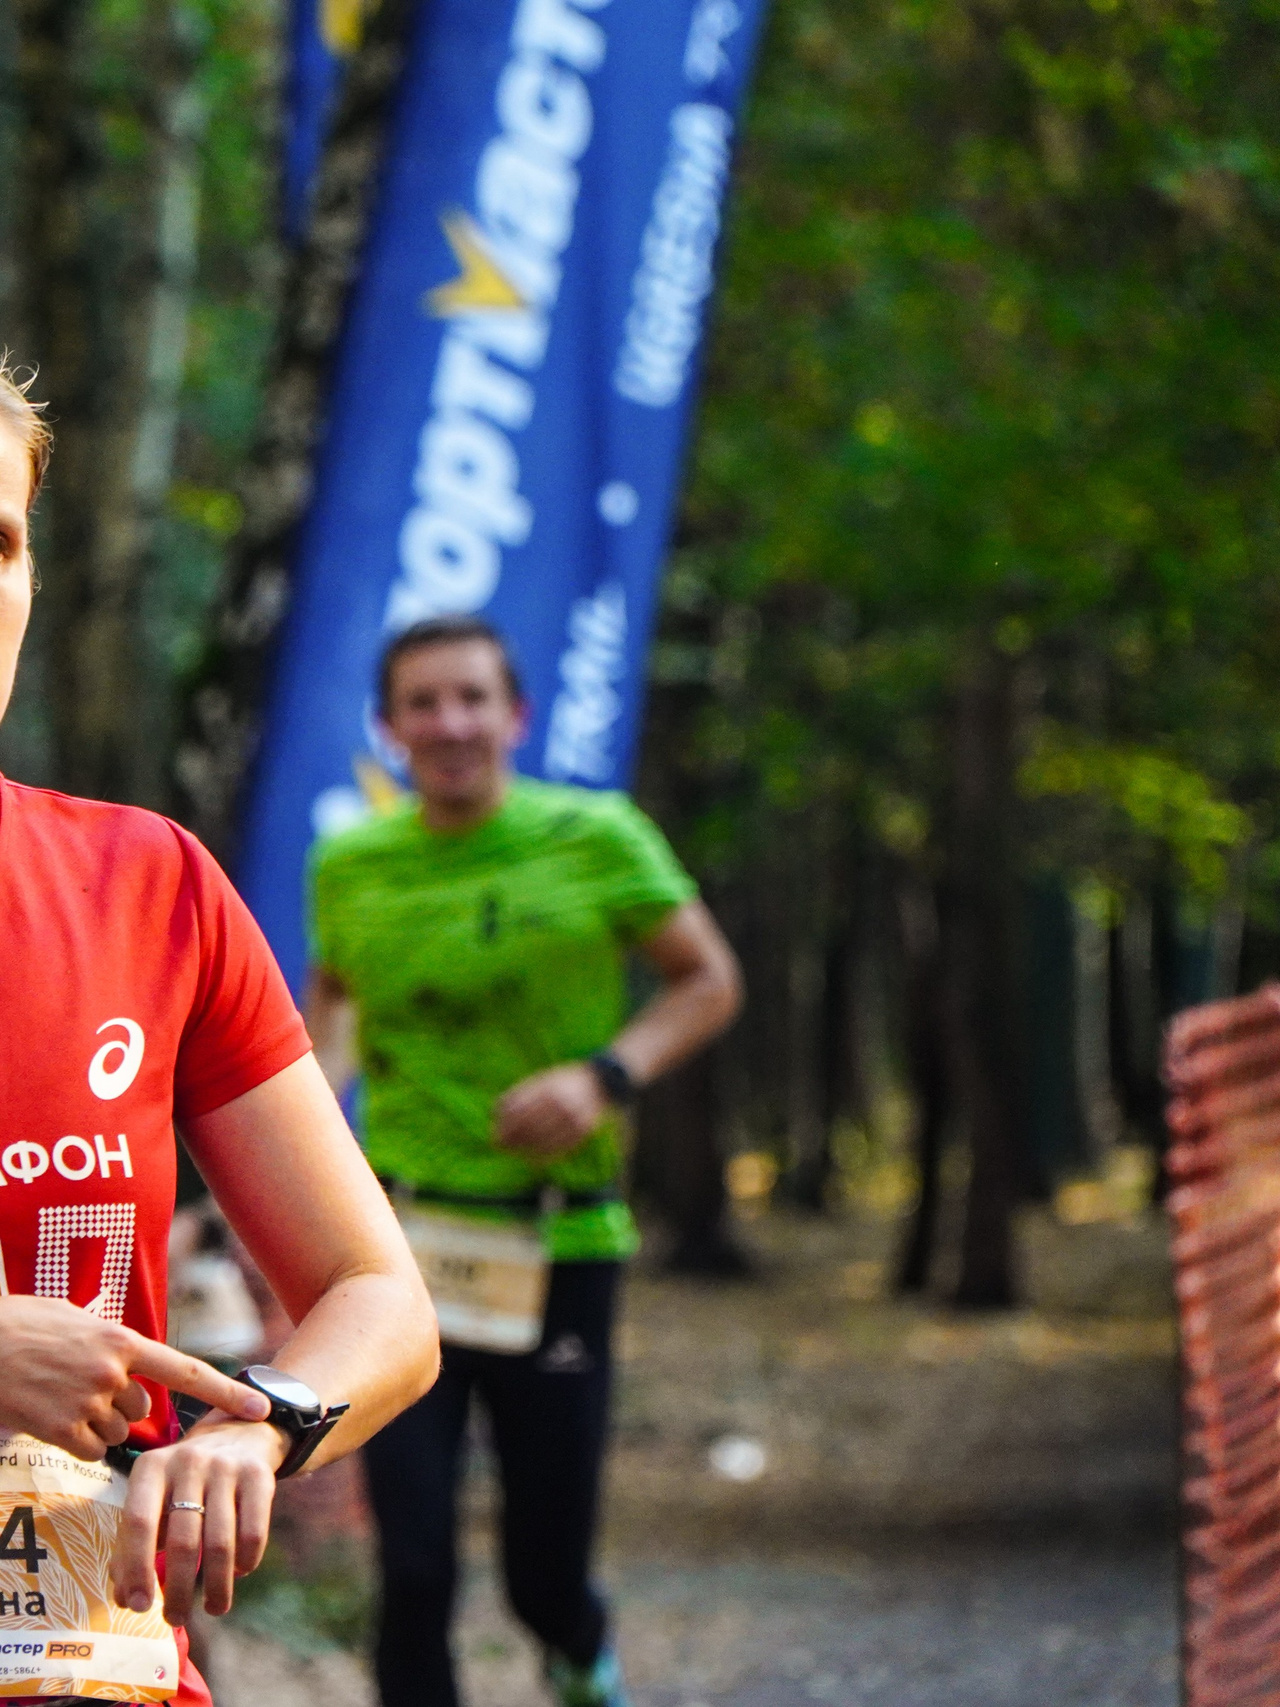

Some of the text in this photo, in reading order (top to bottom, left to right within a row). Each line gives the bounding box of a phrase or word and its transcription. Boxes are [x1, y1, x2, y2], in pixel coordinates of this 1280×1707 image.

[27, 1453, 69, 1471] Ultra
[73, 1462, 114, 1484] Moscow
[48, 1643, 92, 1658] PRO
